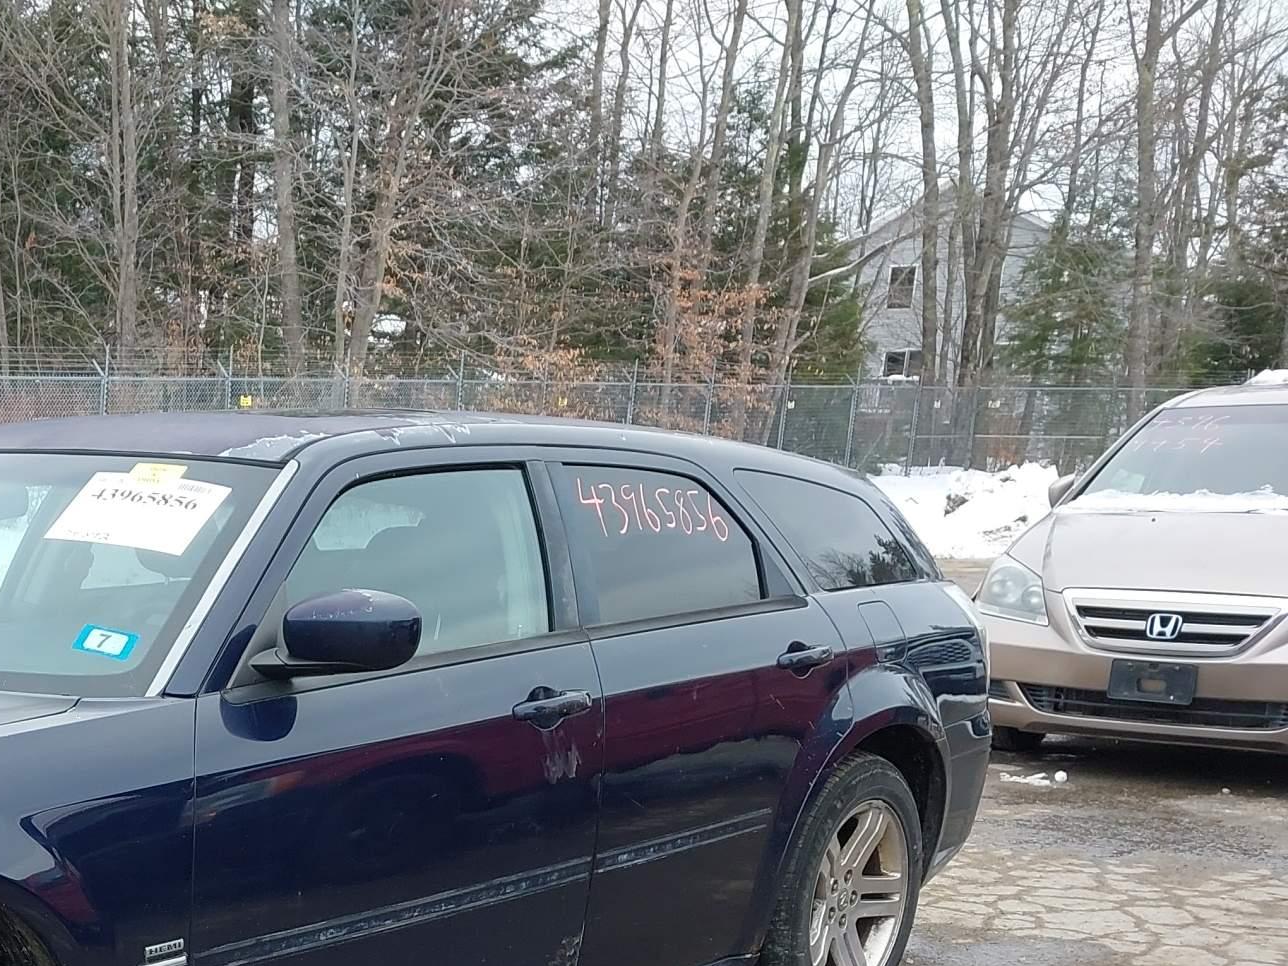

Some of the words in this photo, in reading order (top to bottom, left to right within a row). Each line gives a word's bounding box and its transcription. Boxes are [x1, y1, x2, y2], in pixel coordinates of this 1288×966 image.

[90, 487, 199, 511] 43965856
[576, 477, 729, 542] 43965856
[96, 633, 112, 649] 7
[147, 940, 184, 956] HEMI
